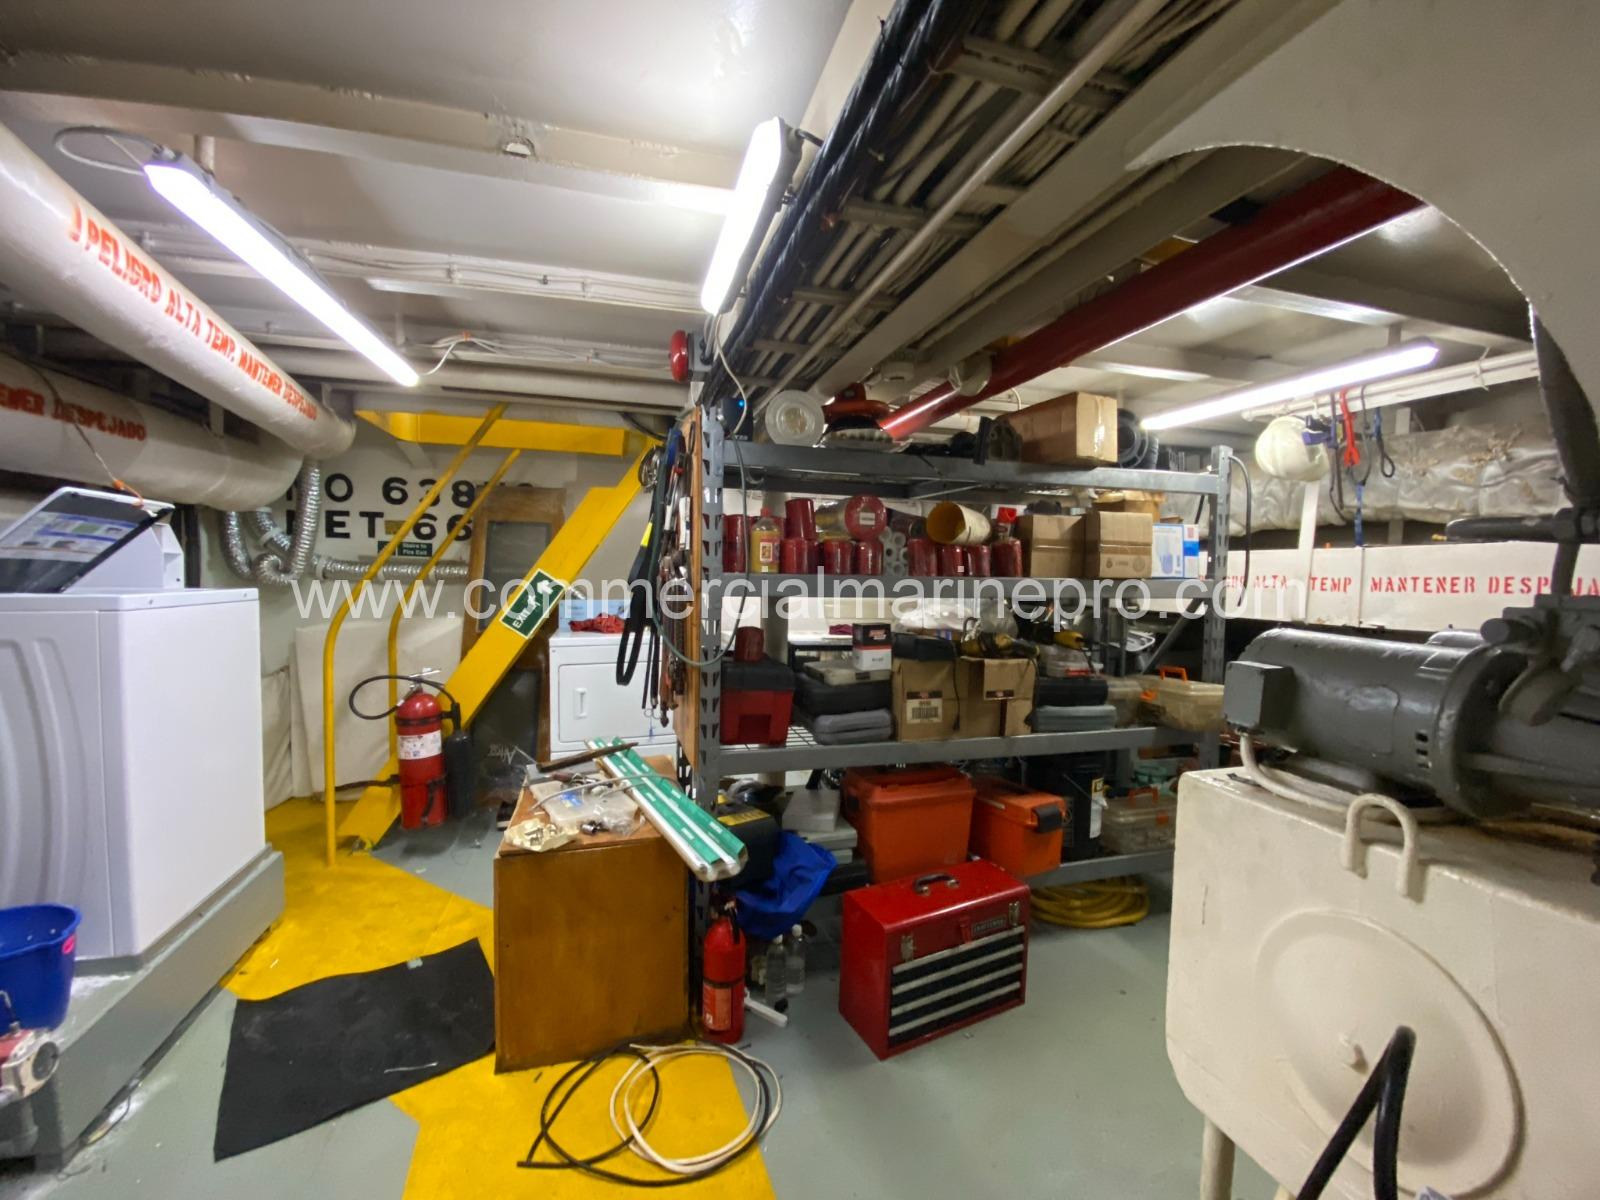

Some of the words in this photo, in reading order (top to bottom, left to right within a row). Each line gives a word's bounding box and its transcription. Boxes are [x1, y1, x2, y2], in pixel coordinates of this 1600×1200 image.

[164, 288, 201, 336] ALTA
[1252, 575, 1288, 589] ALTA
[1309, 576, 1352, 593] TEMP
[1370, 576, 1475, 594] MANTENER
[1488, 575, 1600, 597] DESPJA
